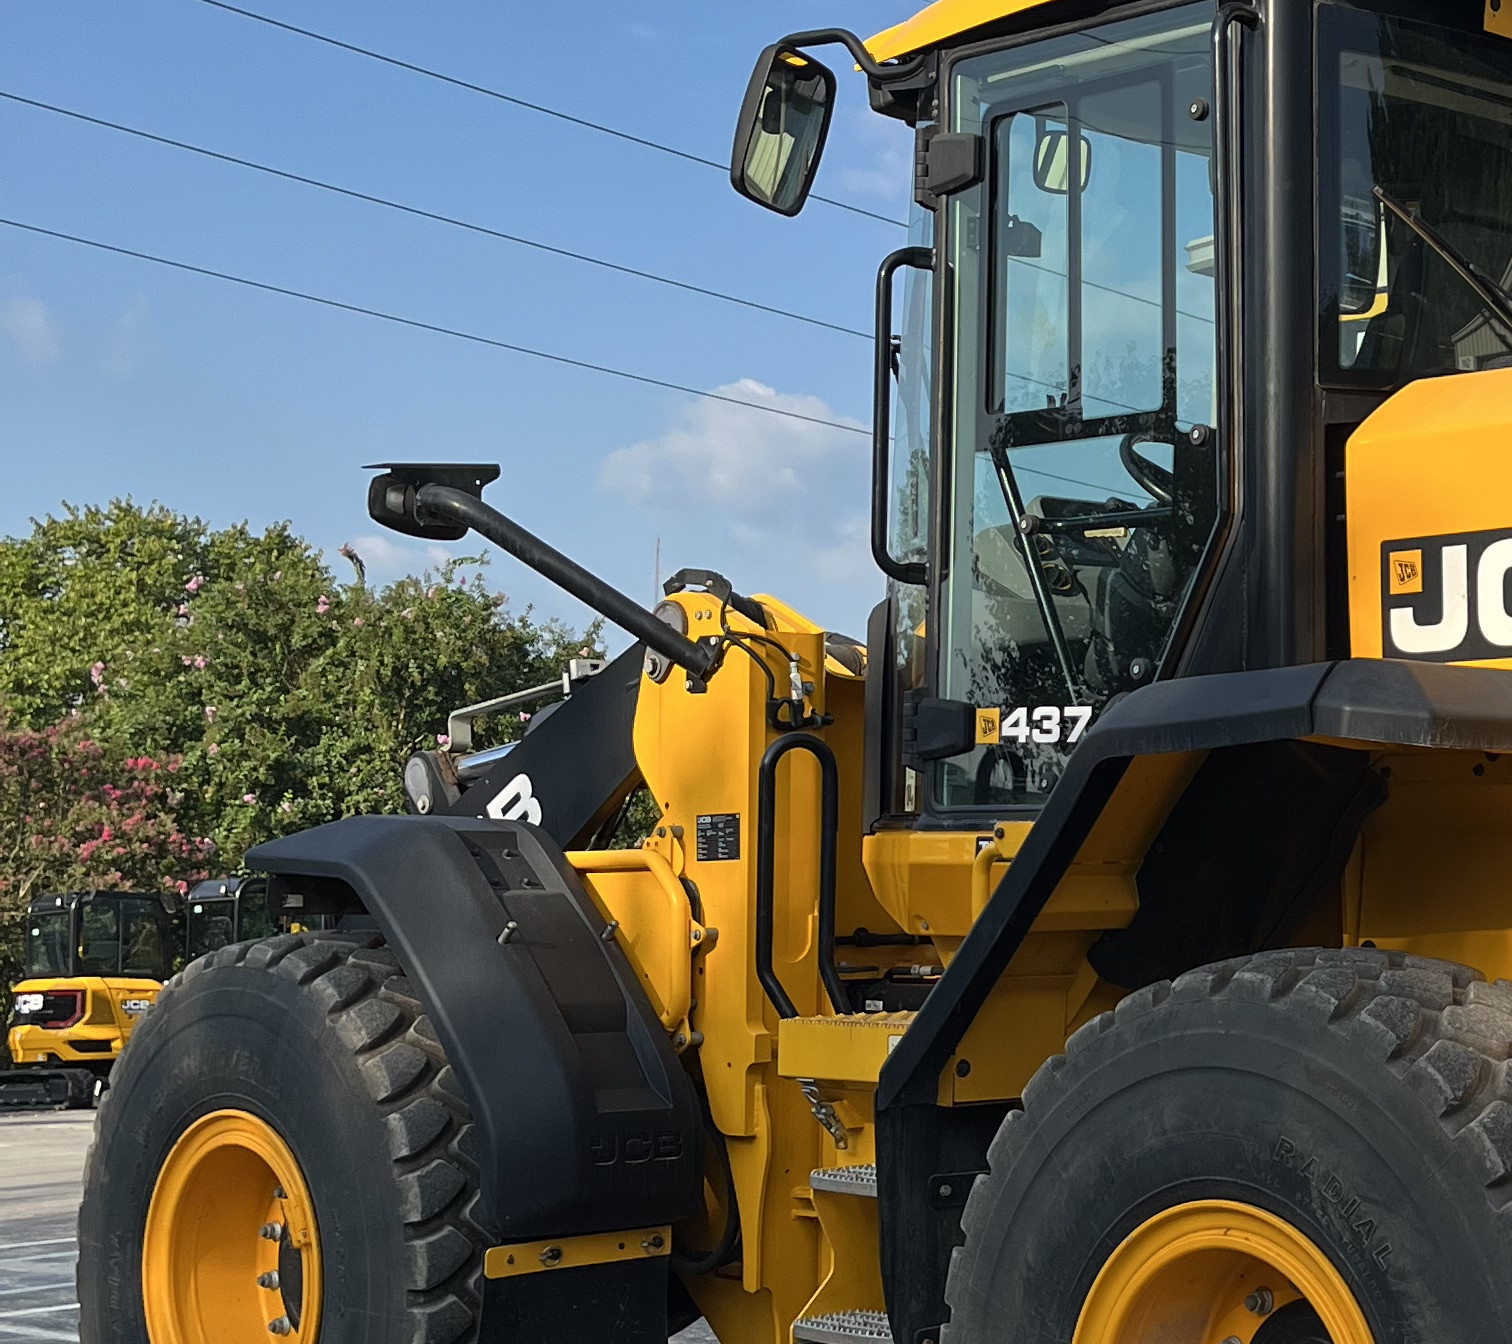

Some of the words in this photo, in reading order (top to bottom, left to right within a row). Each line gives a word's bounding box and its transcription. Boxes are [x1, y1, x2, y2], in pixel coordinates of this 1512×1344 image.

[1001, 706, 1093, 743] 437
[591, 1130, 684, 1166] JCB
[1273, 1135, 1393, 1272] RADIAL
